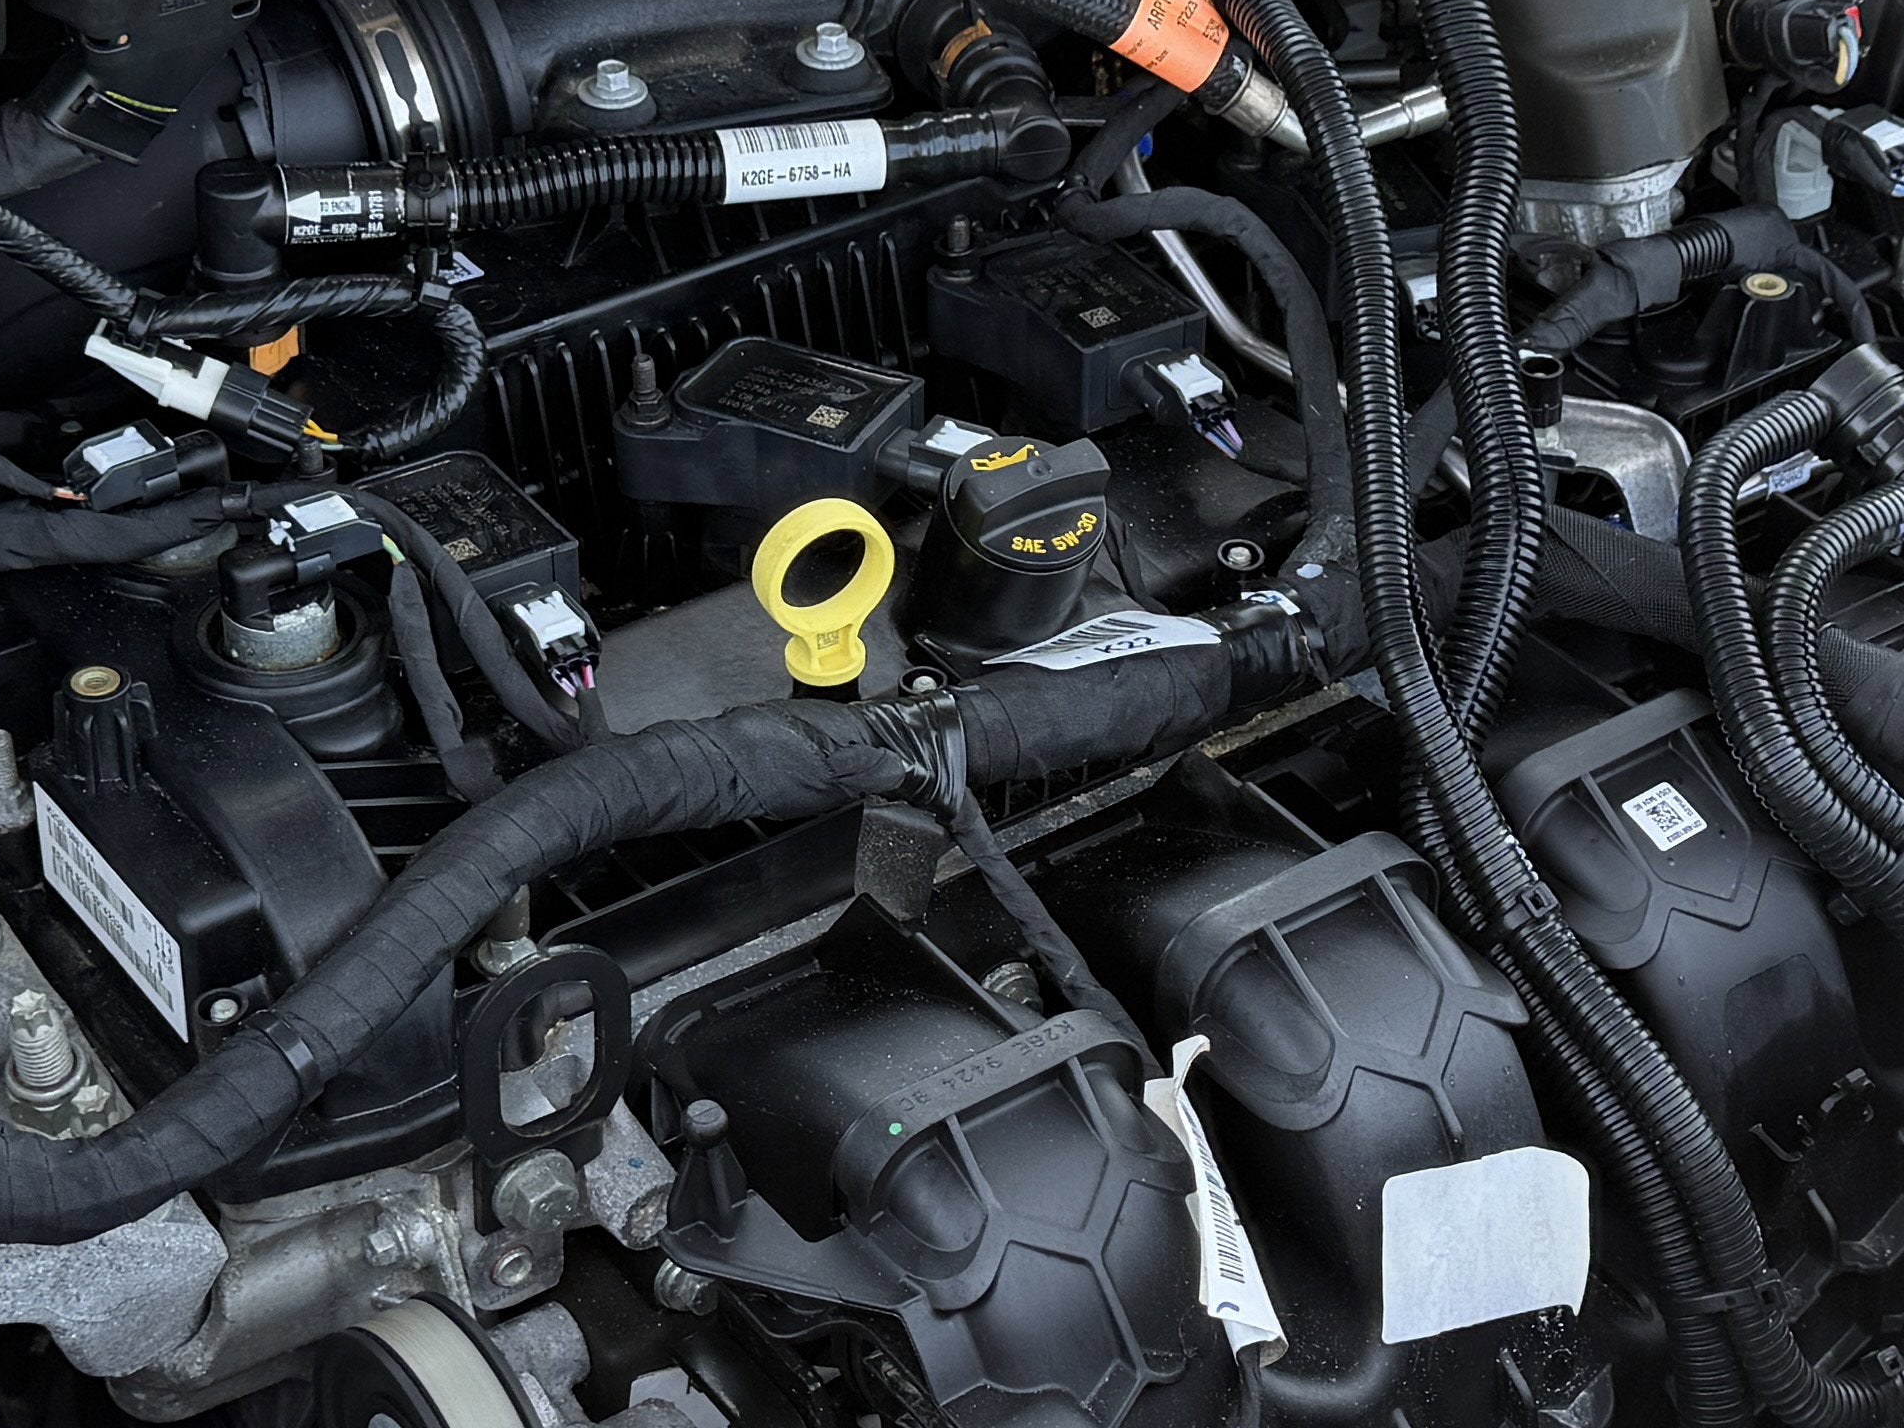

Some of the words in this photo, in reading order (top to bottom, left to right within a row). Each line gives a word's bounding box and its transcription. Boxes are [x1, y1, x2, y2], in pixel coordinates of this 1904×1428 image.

[741, 163, 852, 187] K2GE-6758-HA
[1011, 536, 1047, 554] SAE
[1052, 511, 1098, 553] 5W-30
